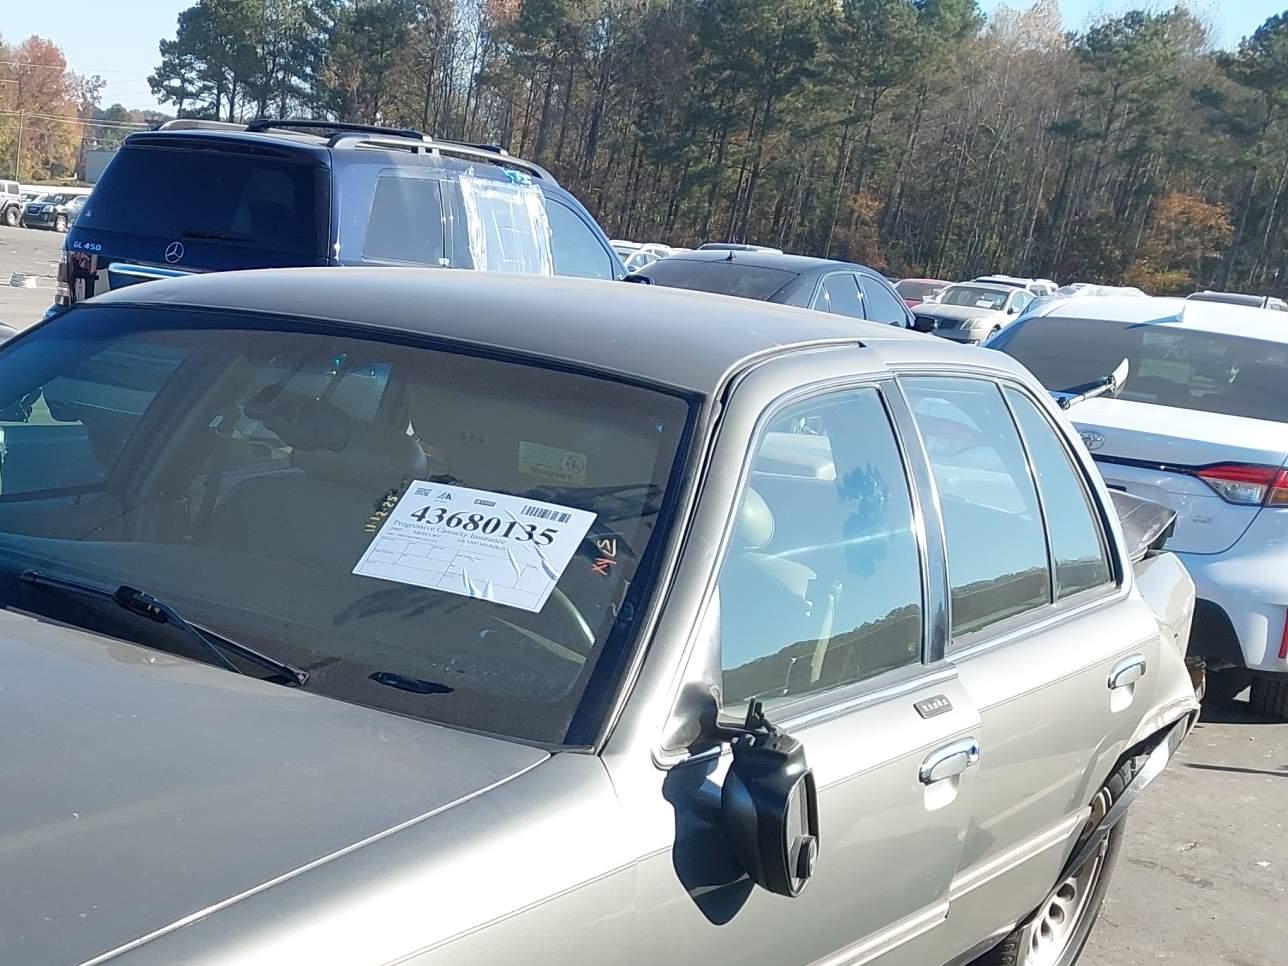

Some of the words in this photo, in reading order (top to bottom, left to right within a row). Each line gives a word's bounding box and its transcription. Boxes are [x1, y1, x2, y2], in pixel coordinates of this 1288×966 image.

[73, 241, 83, 249] GL
[83, 242, 102, 251] 450
[393, 519, 436, 532] Progressive
[437, 527, 468, 539] Casualty
[470, 532, 506, 545] Insurance
[410, 505, 559, 546] 43680135
